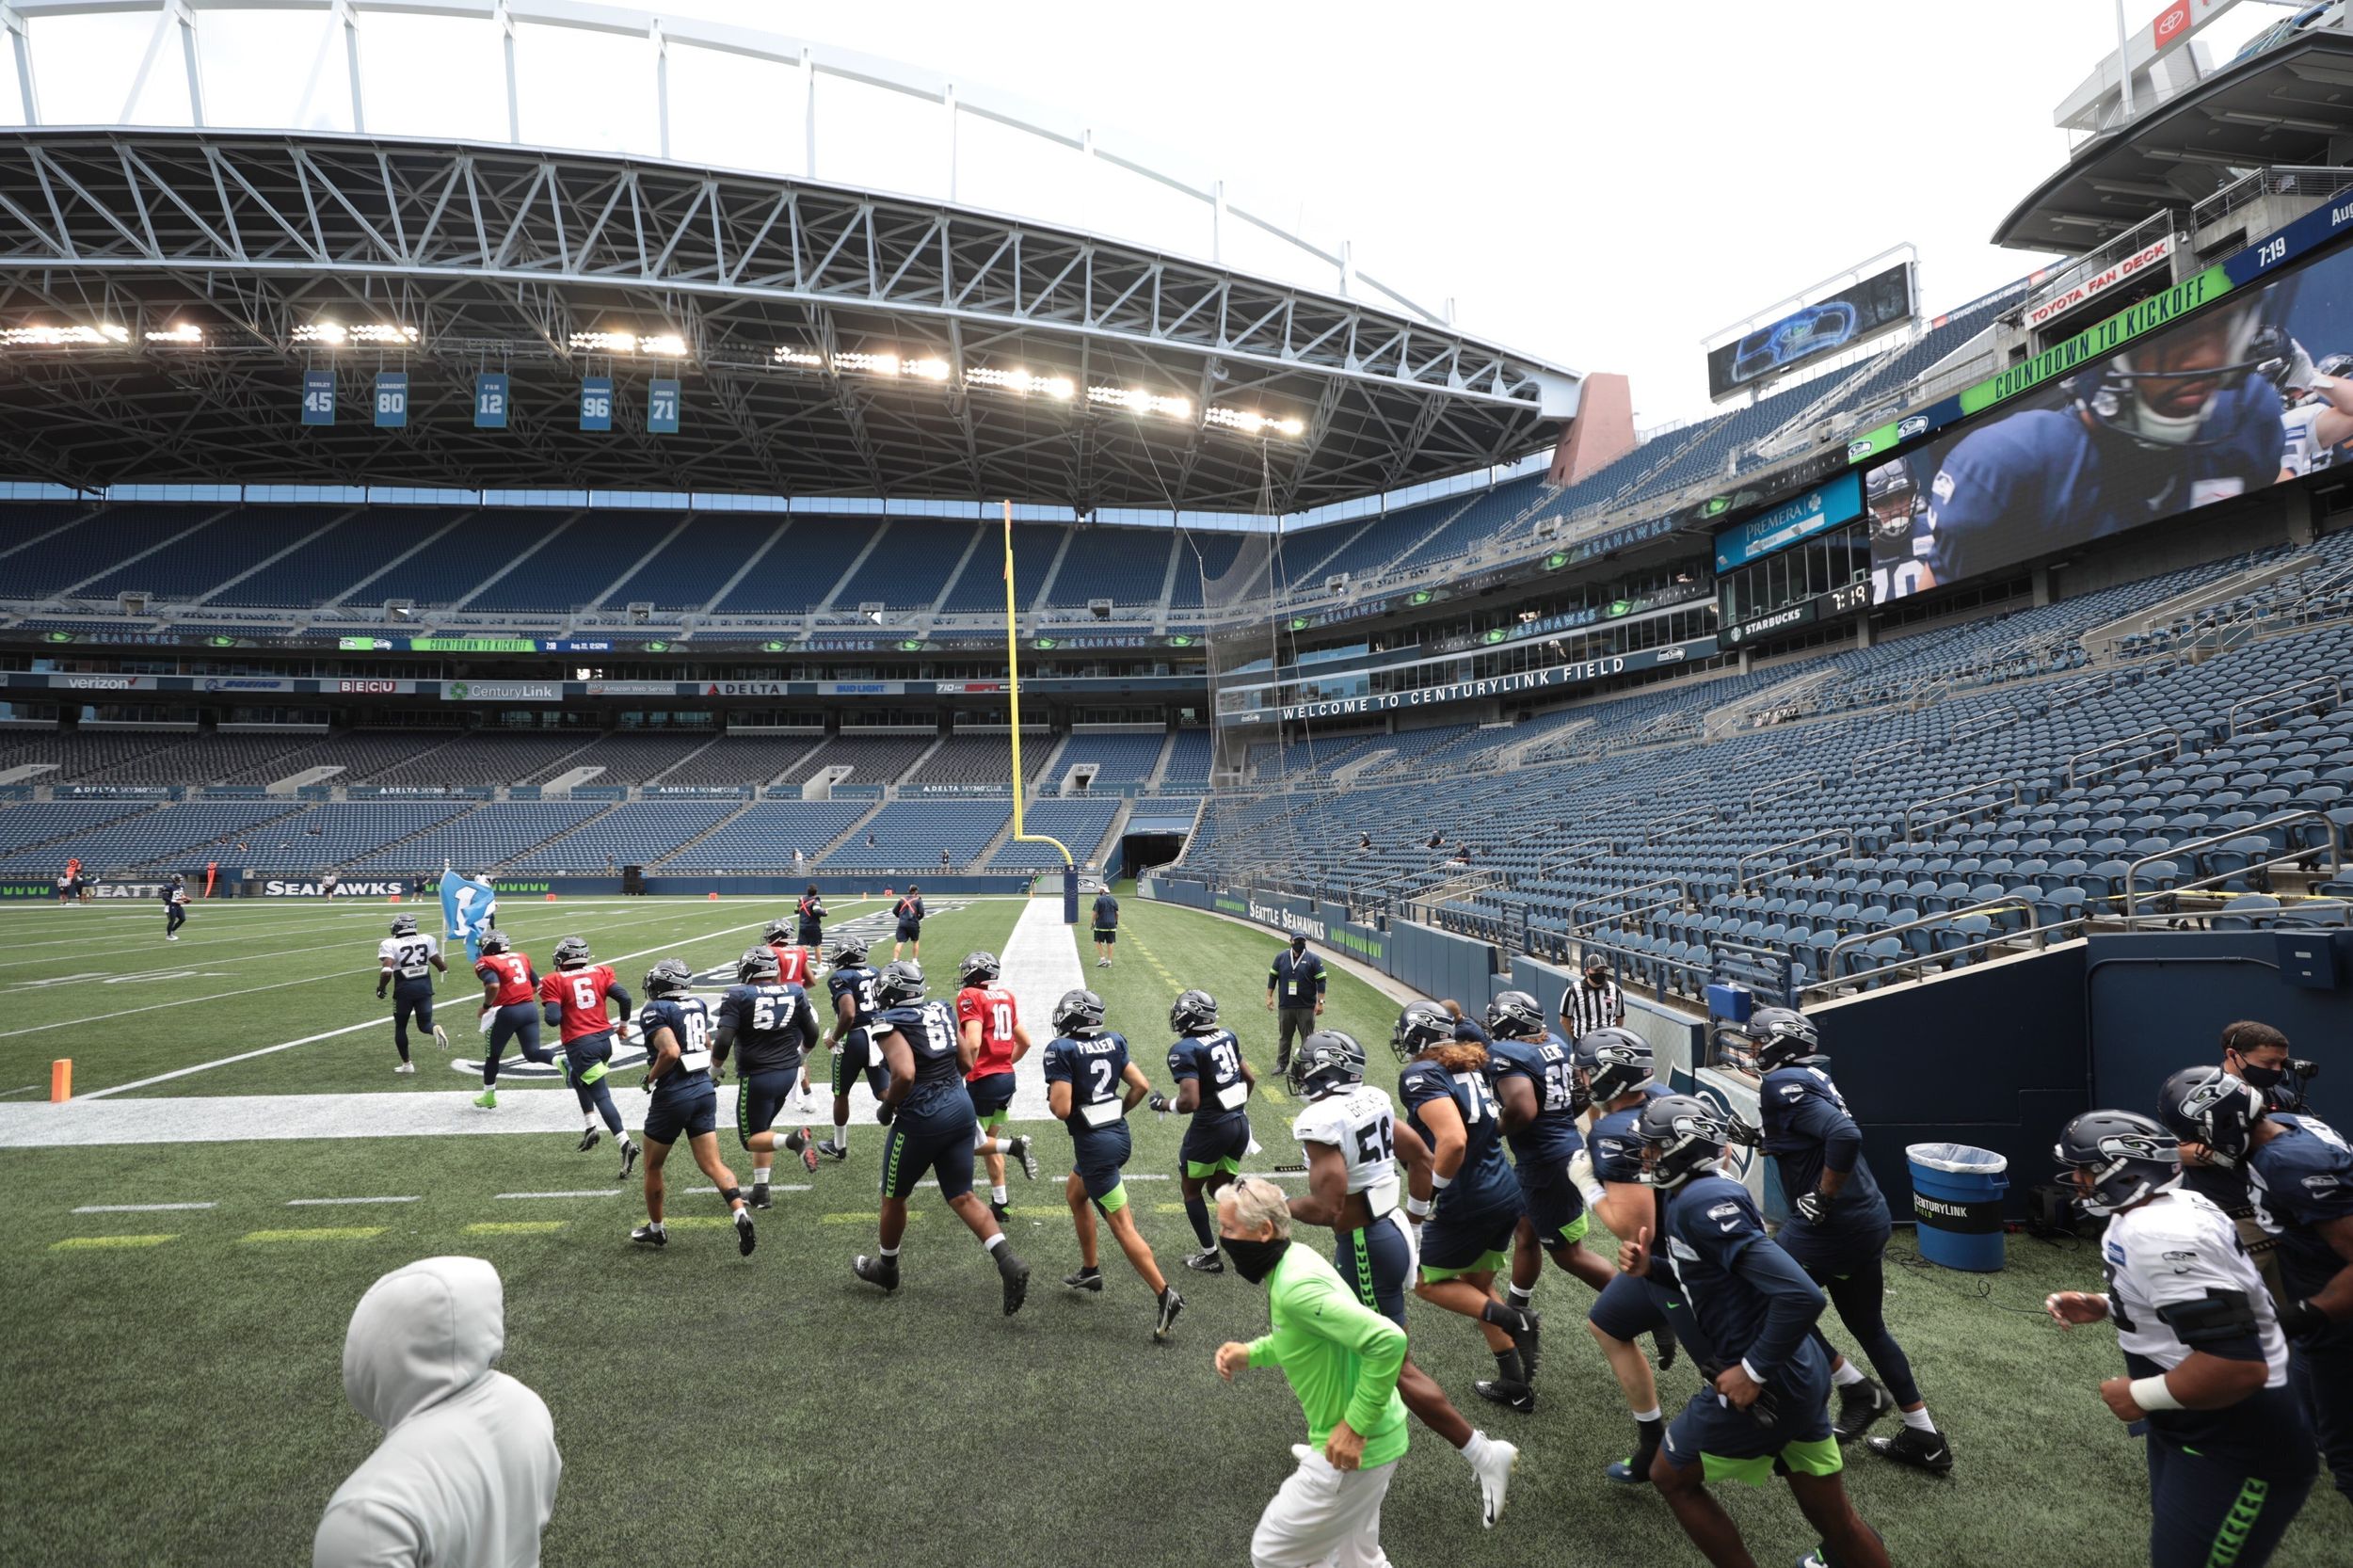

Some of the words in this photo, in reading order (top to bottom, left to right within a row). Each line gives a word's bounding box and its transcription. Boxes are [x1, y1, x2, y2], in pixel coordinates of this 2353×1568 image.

[2257, 236, 2286, 267] 7:19
[2030, 290, 2085, 323] TOYOTA
[2088, 270, 2117, 293] FAN
[2122, 243, 2167, 275] DECK
[1947, 300, 1981, 322] TOYOTA
[1980, 292, 1998, 307] FAN
[1995, 333, 2090, 399] COUNTDOWN
[2098, 321, 2118, 350] TO
[2125, 275, 2206, 337] KICKOFF
[304, 392, 333, 412] 45
[377, 393, 405, 413] 80
[479, 393, 503, 414] 12
[583, 397, 610, 418] 96
[652, 400, 675, 420] 71
[1746, 504, 1802, 542] PREMERA
[1583, 517, 1673, 558] SEAHAWKS
[1833, 585, 1865, 610] 7:19
[1320, 602, 1387, 625] SEAHAWKS
[1515, 609, 1596, 636] SEAHAWKS
[1745, 608, 1801, 634] STARBUCKS
[89, 633, 181, 645] SEAHAWKS
[429, 639, 479, 650] COUNTDOWN
[482, 639, 492, 650] TO
[494, 639, 528, 650] KICKOFF
[800, 640, 874, 651] SEAHAWKS
[1069, 636, 1146, 648] SEAHAWKS
[69, 676, 130, 689] verizon
[223, 680, 282, 688] BOEING
[472, 685, 552, 699] CenturyLink
[726, 684, 780, 694] DELTA
[936, 683, 954, 692] 710
[1283, 698, 1369, 720] WELCOME
[1378, 696, 1400, 710] TO
[1410, 670, 1550, 705] CENTURYLINK
[1562, 658, 1625, 681] FIELD
[1249, 901, 1280, 926] SEATTLE
[1282, 907, 1325, 941] SEAHAWKS
[399, 943, 428, 968] 23
[784, 952, 798, 980] 7
[507, 958, 527, 984] 3
[572, 977, 597, 1010] 6
[753, 995, 796, 1031] 67
[992, 1003, 1013, 1041] 10
[683, 1012, 707, 1051] 18
[1076, 1037, 1116, 1055] FULLER
[1210, 1040, 1240, 1084] 31
[1090, 1058, 1114, 1103] 2
[1452, 1071, 1500, 1124] 75
[1915, 1194, 1967, 1218] CENTURYLINK
